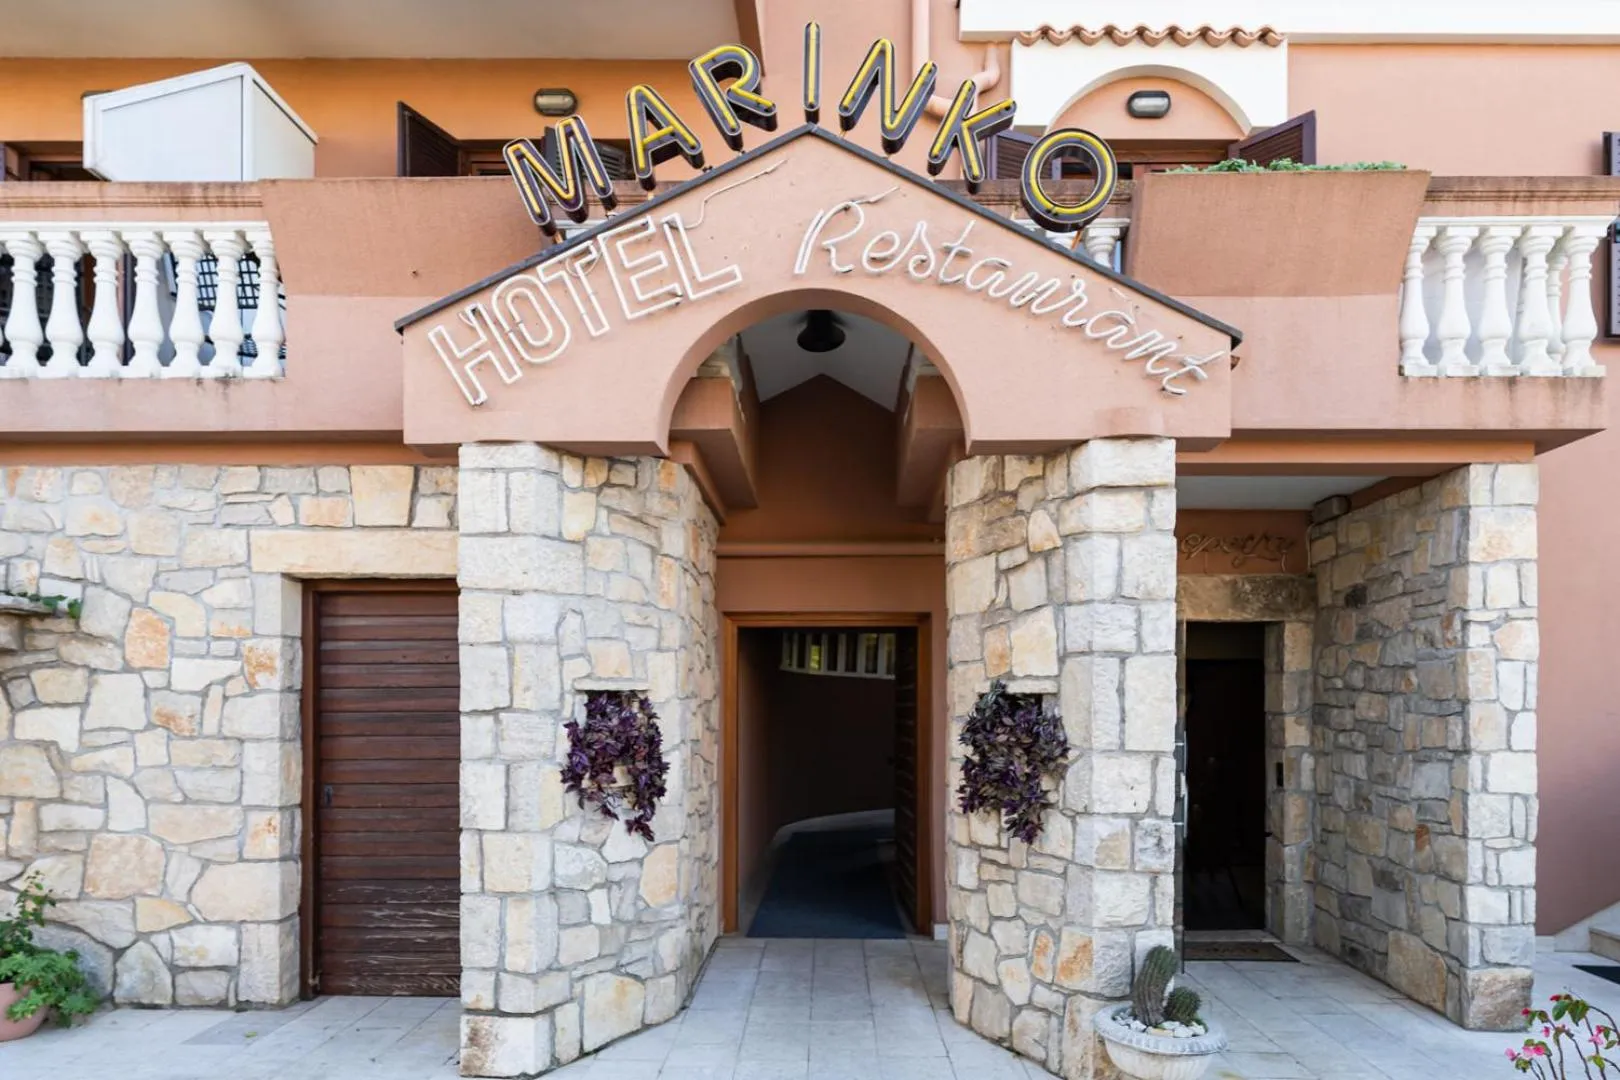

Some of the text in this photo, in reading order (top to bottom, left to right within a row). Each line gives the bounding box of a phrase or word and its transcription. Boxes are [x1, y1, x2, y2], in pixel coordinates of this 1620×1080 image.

[501, 21, 1119, 232] MARINKO
[427, 200, 1225, 406] HOTEL Restaurant
